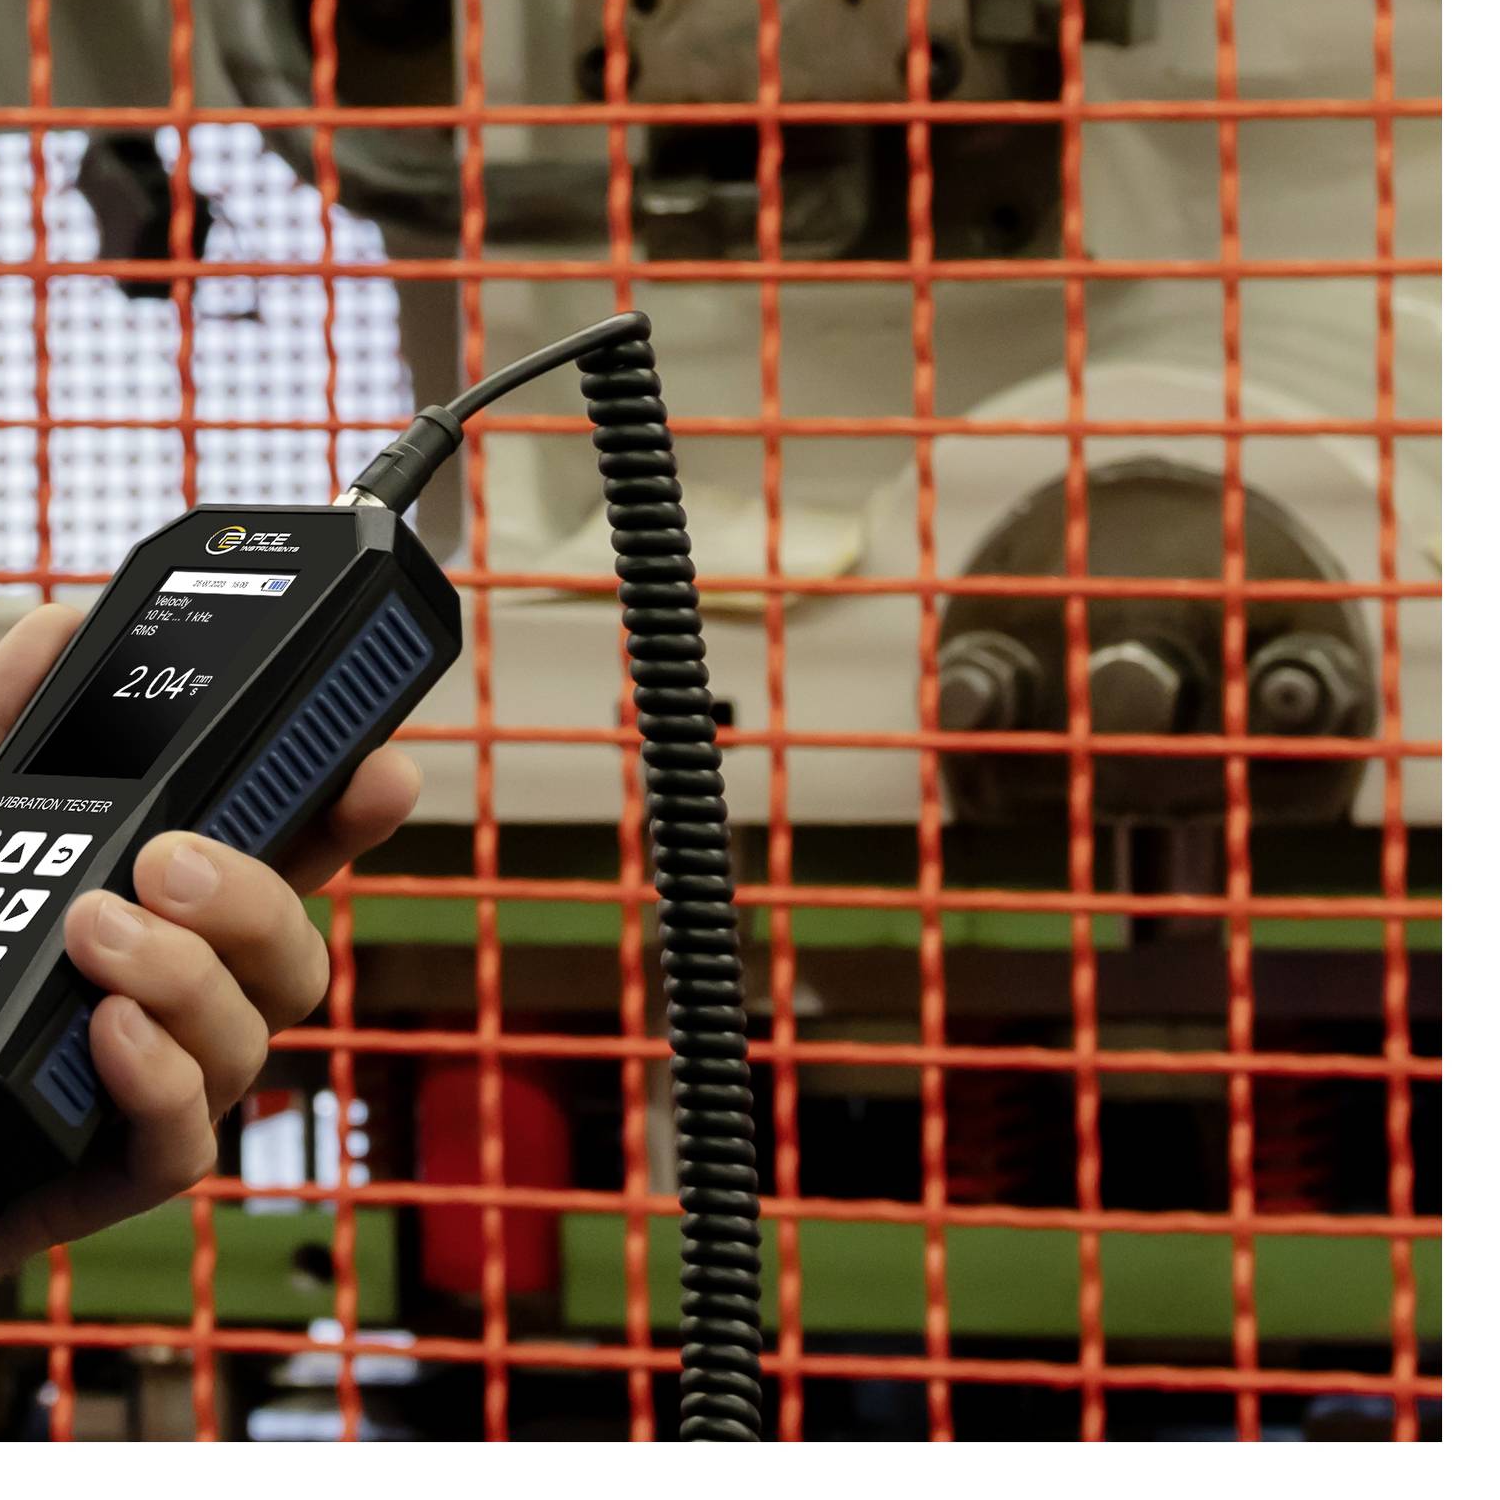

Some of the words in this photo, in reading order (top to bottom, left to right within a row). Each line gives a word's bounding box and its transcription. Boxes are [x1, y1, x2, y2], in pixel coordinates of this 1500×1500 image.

[245, 532, 292, 546] PCE
[239, 545, 301, 553] INSTRUMENTS
[155, 595, 192, 609] Velocity
[144, 609, 159, 621] 10
[184, 611, 194, 622] 1
[191, 612, 213, 623] kHz
[130, 624, 159, 636] RMS
[112, 665, 196, 700] 2.04
[191, 674, 214, 684] mm
[62, 799, 113, 813] TESTER
